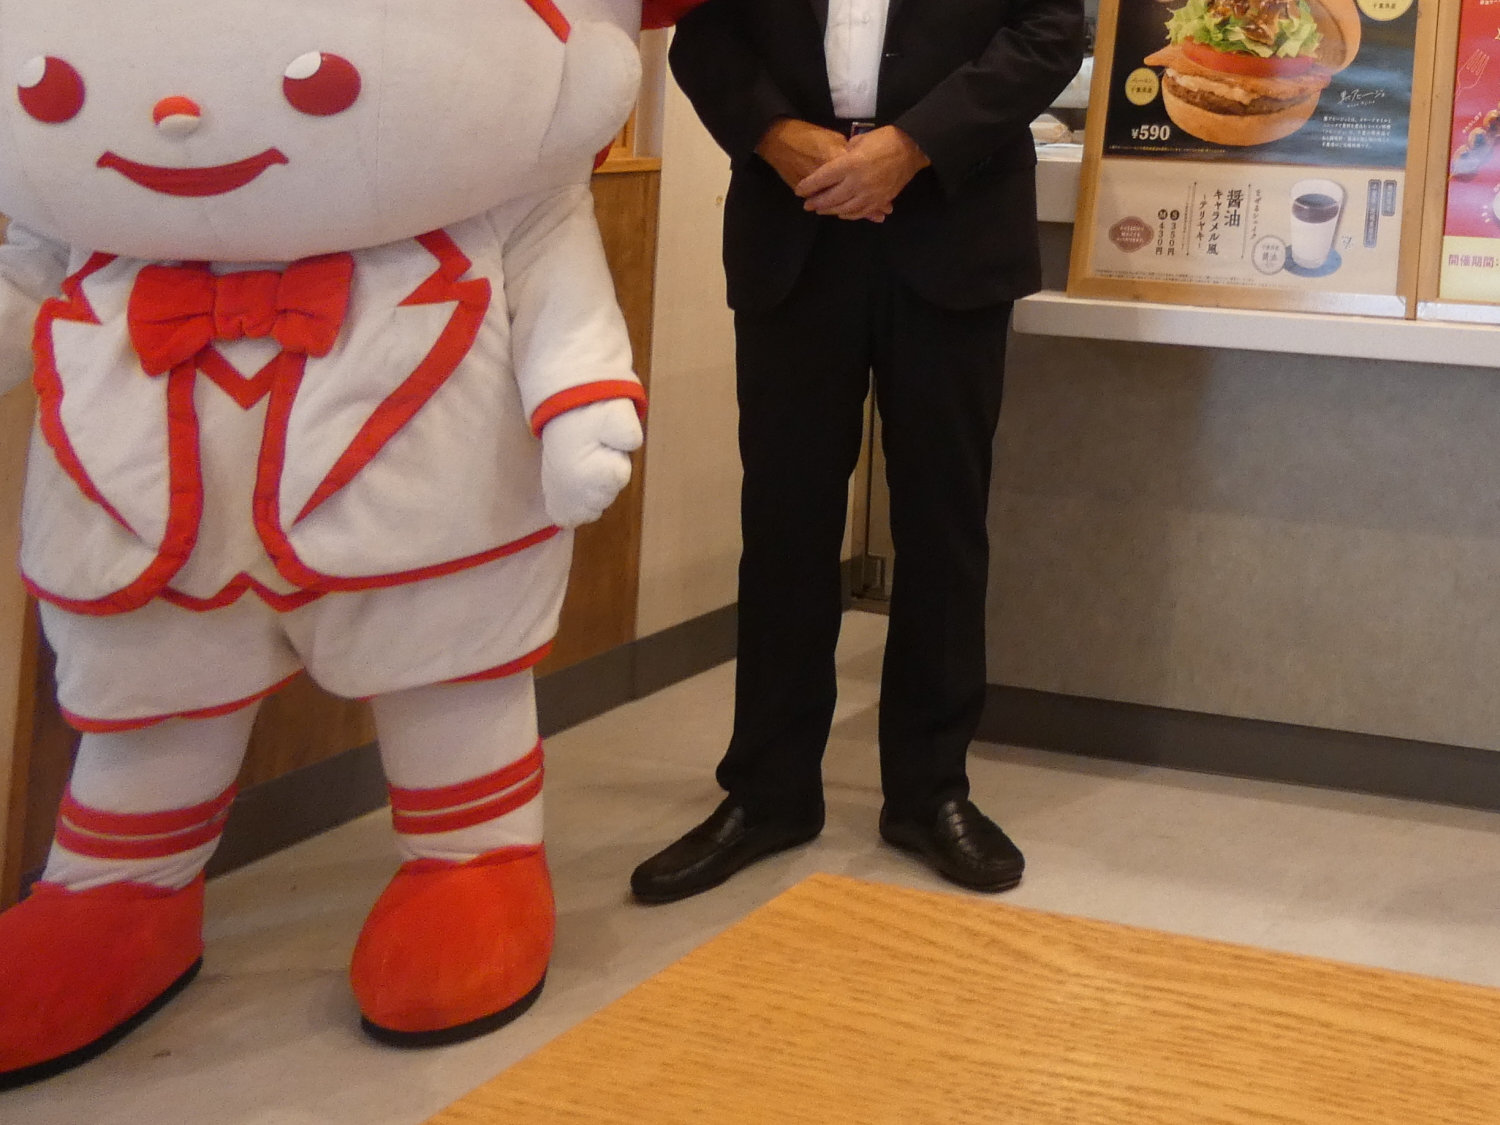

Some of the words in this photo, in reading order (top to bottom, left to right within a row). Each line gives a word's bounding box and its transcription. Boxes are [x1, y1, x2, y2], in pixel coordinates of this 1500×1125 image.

[1131, 124, 1171, 141] ¥590
[1207, 189, 1223, 255] キャラメル風
[1224, 189, 1243, 227] 醤油
